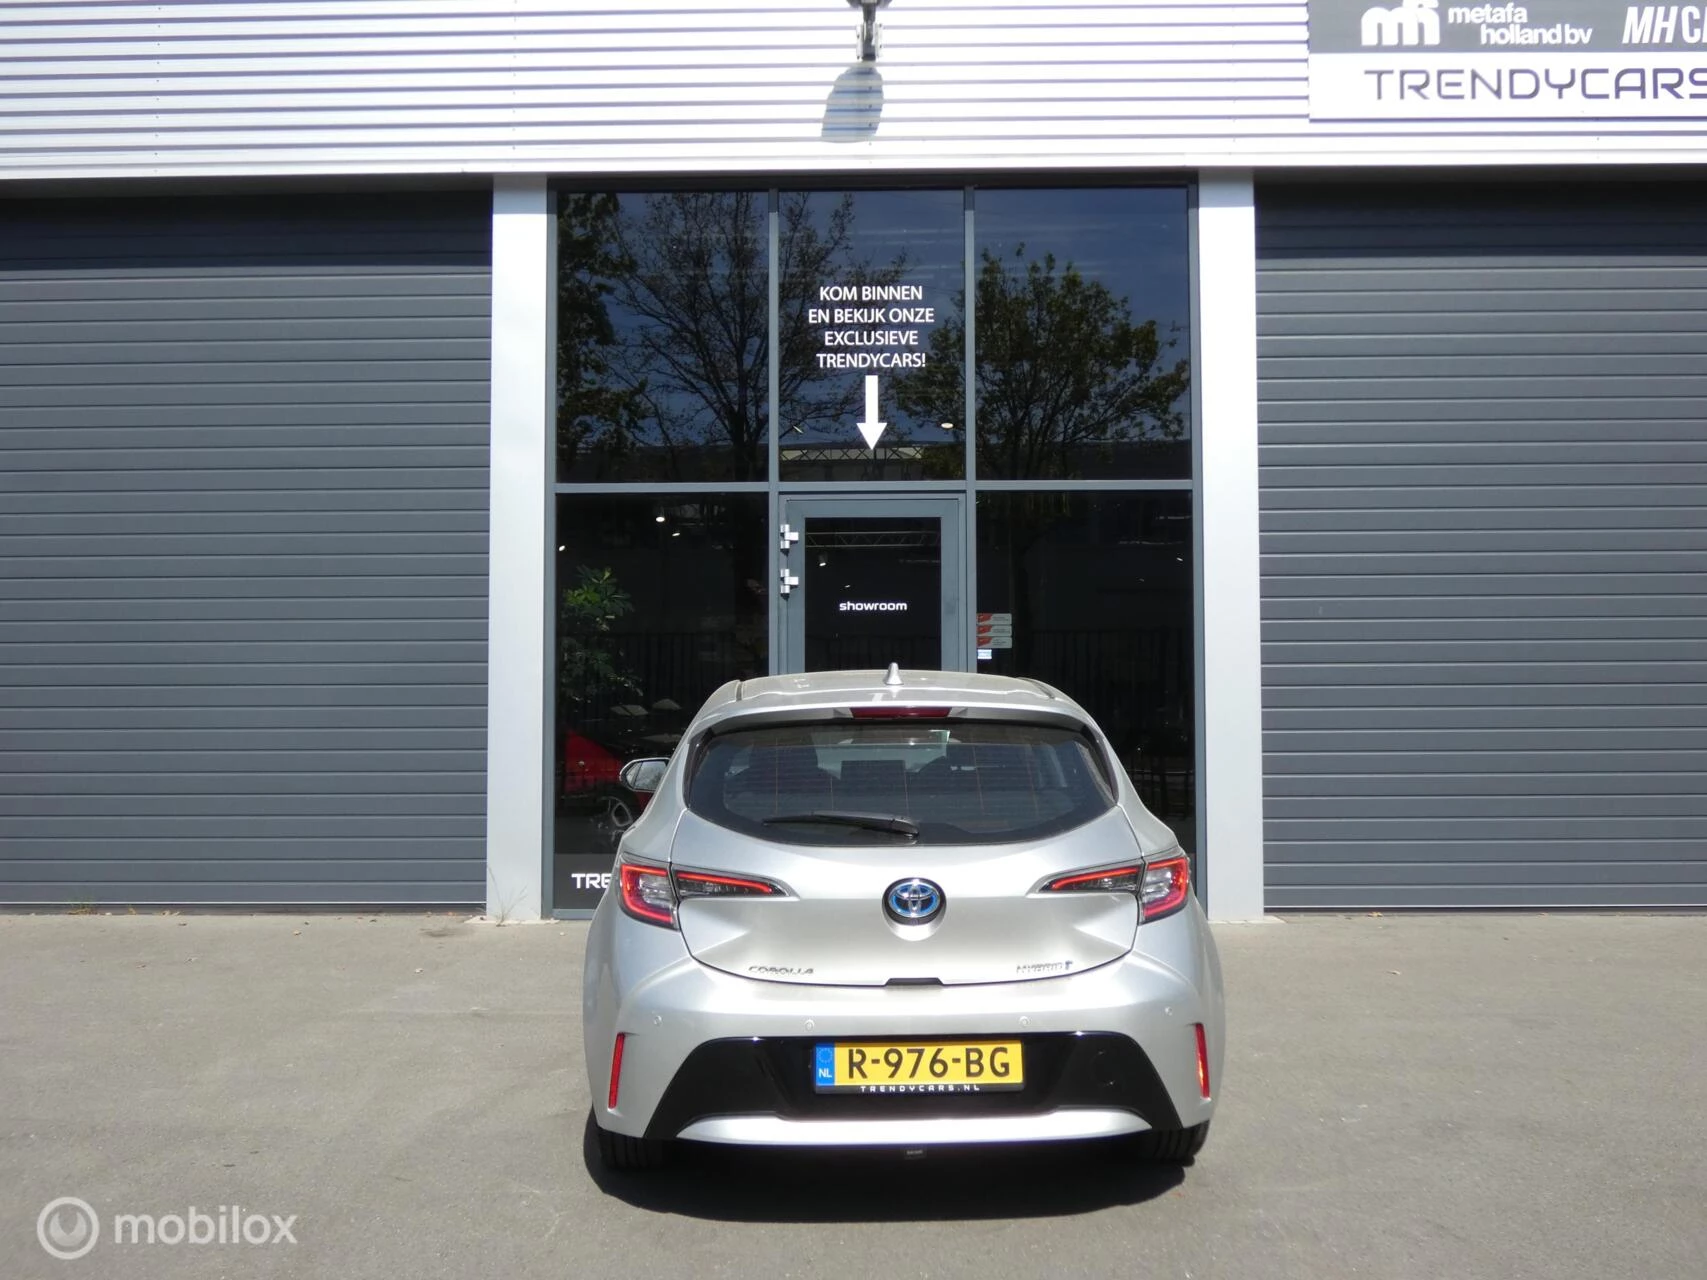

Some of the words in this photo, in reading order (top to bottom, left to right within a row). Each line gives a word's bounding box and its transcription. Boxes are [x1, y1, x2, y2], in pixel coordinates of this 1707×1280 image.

[1448, 3, 1528, 24] metafa
[1364, 68, 1707, 100] TRENDYCARS
[819, 286, 857, 301] KOM
[862, 286, 923, 300] BINNEN
[808, 309, 830, 323] EN
[834, 308, 886, 324] BEKIJK
[889, 308, 935, 323] ONZE
[824, 331, 918, 345] EXCLUSIEVE
[816, 353, 926, 368] TRENDYCARS!
[839, 601, 908, 611] showroom
[848, 1047, 1011, 1079] R-976-BG
[818, 1069, 833, 1078] NL
[860, 1084, 980, 1093] TRENDYCARS.NL
